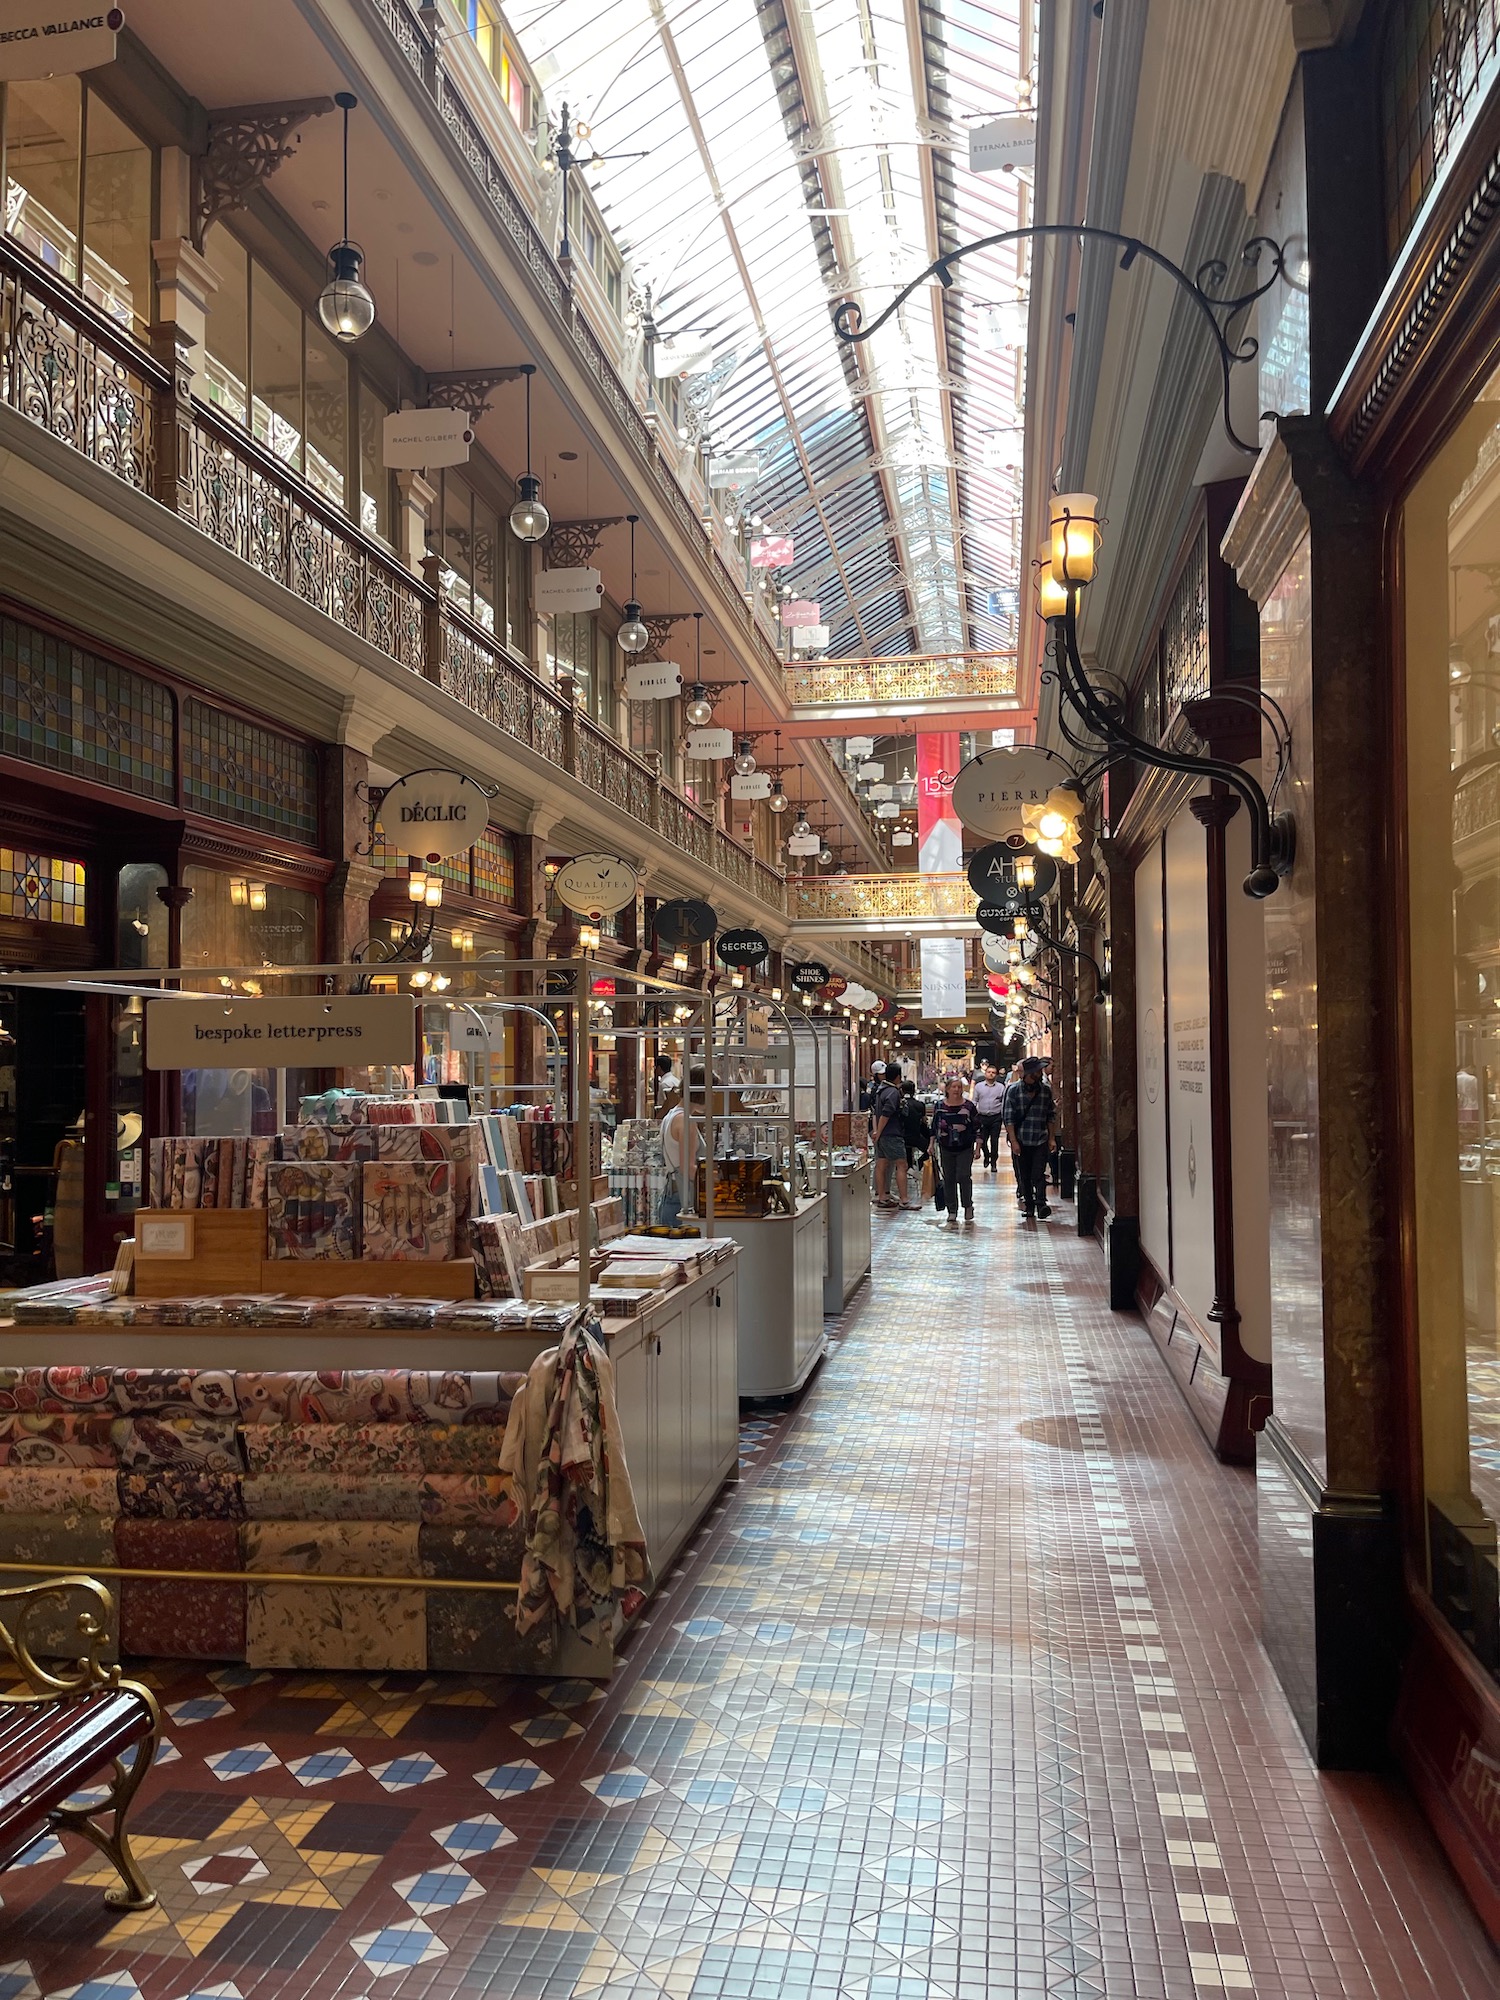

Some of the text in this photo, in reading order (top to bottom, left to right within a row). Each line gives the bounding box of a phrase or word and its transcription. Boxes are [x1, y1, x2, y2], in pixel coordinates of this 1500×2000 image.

[0, 17, 104, 42] BECCA VALLANCE
[973, 138, 1037, 152] ETERNAL BRIDA
[425, 434, 458, 442] GILBERT
[921, 775, 956, 792] 150
[401, 801, 466, 822] DÉCLIC
[984, 803, 1020, 813] Diam
[1013, 836, 1019, 844] 7
[995, 875, 1018, 884] STUD
[721, 942, 763, 952] SECRETS
[800, 968, 821, 976] SHOE
[796, 975, 825, 983] SHINES
[923, 983, 963, 991] NIESSING
[195, 1023, 362, 1043] bespoke letterpress
